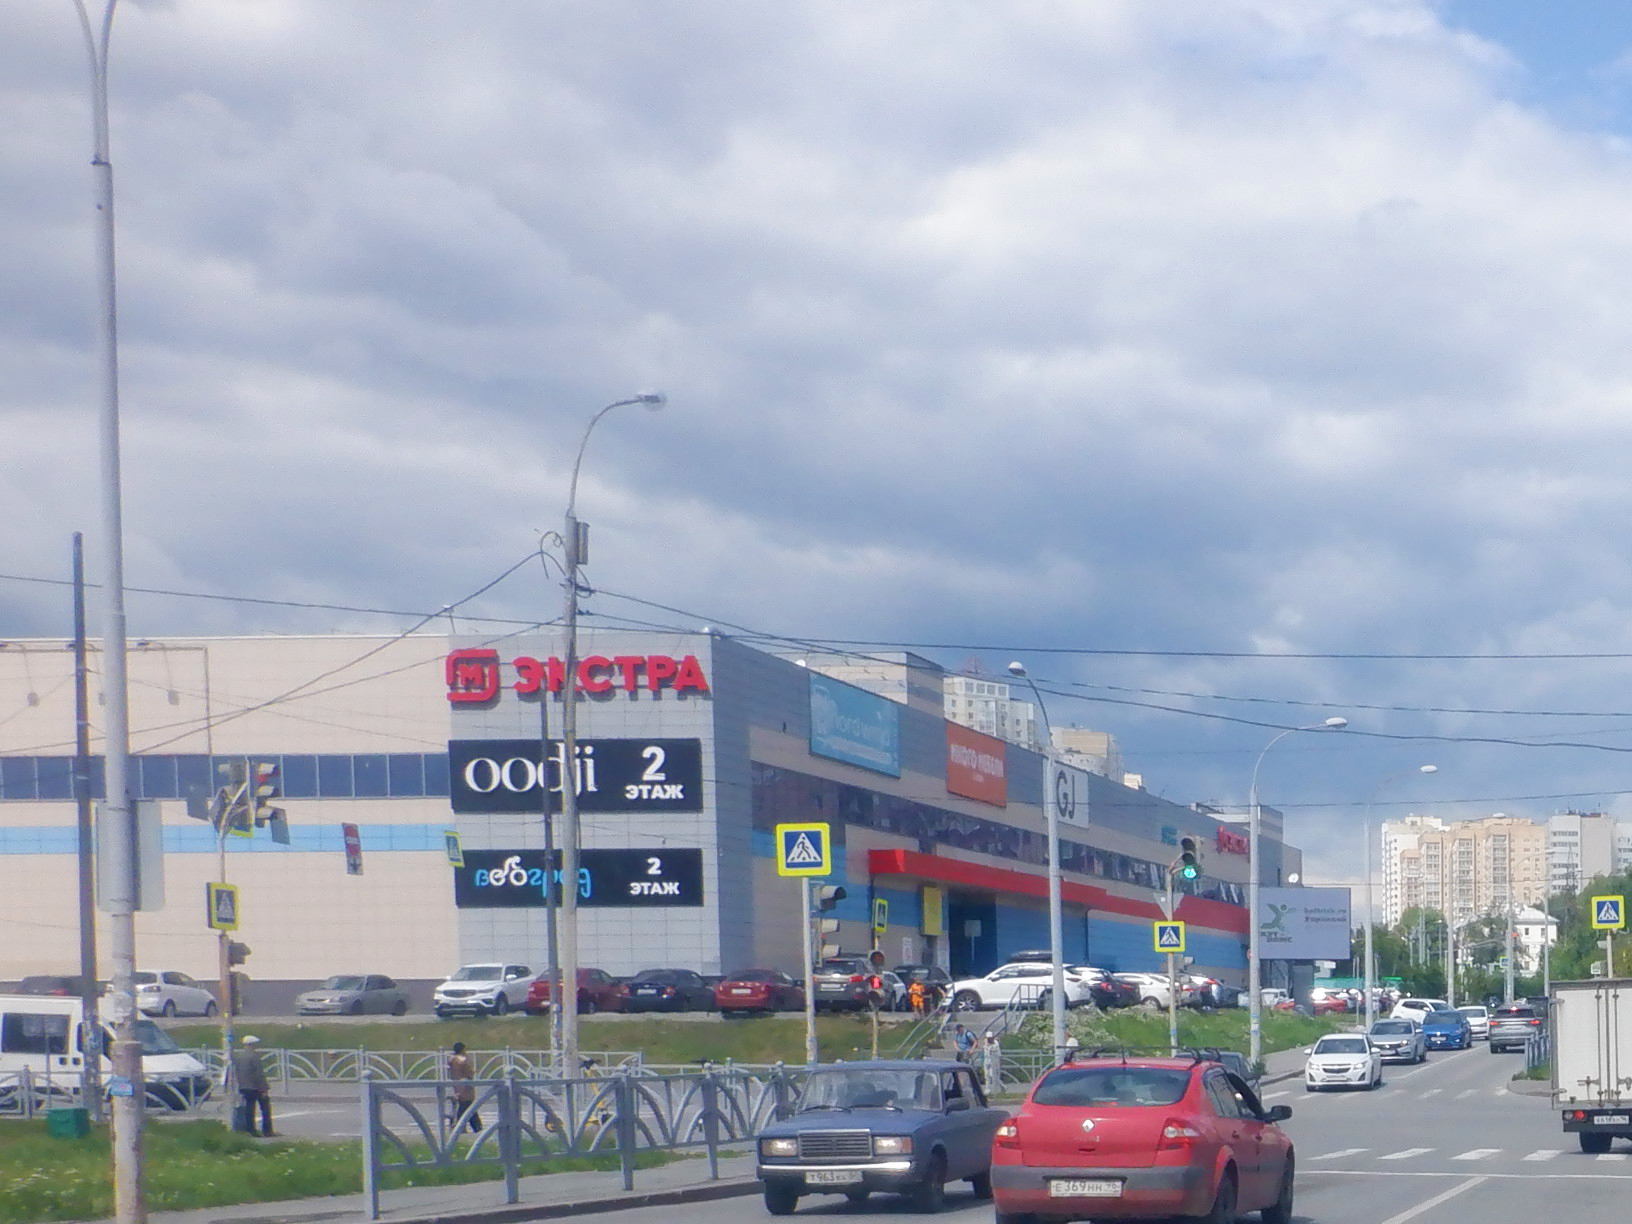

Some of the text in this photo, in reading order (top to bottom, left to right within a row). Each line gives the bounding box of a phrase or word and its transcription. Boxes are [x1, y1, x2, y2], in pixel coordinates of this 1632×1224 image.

[513, 655, 709, 693] ЭКСТРА
[641, 746, 666, 781] 2
[625, 784, 684, 800] ЭТАЖ
[646, 857, 662, 875] 2
[630, 881, 680, 895] ЭТАЖ
